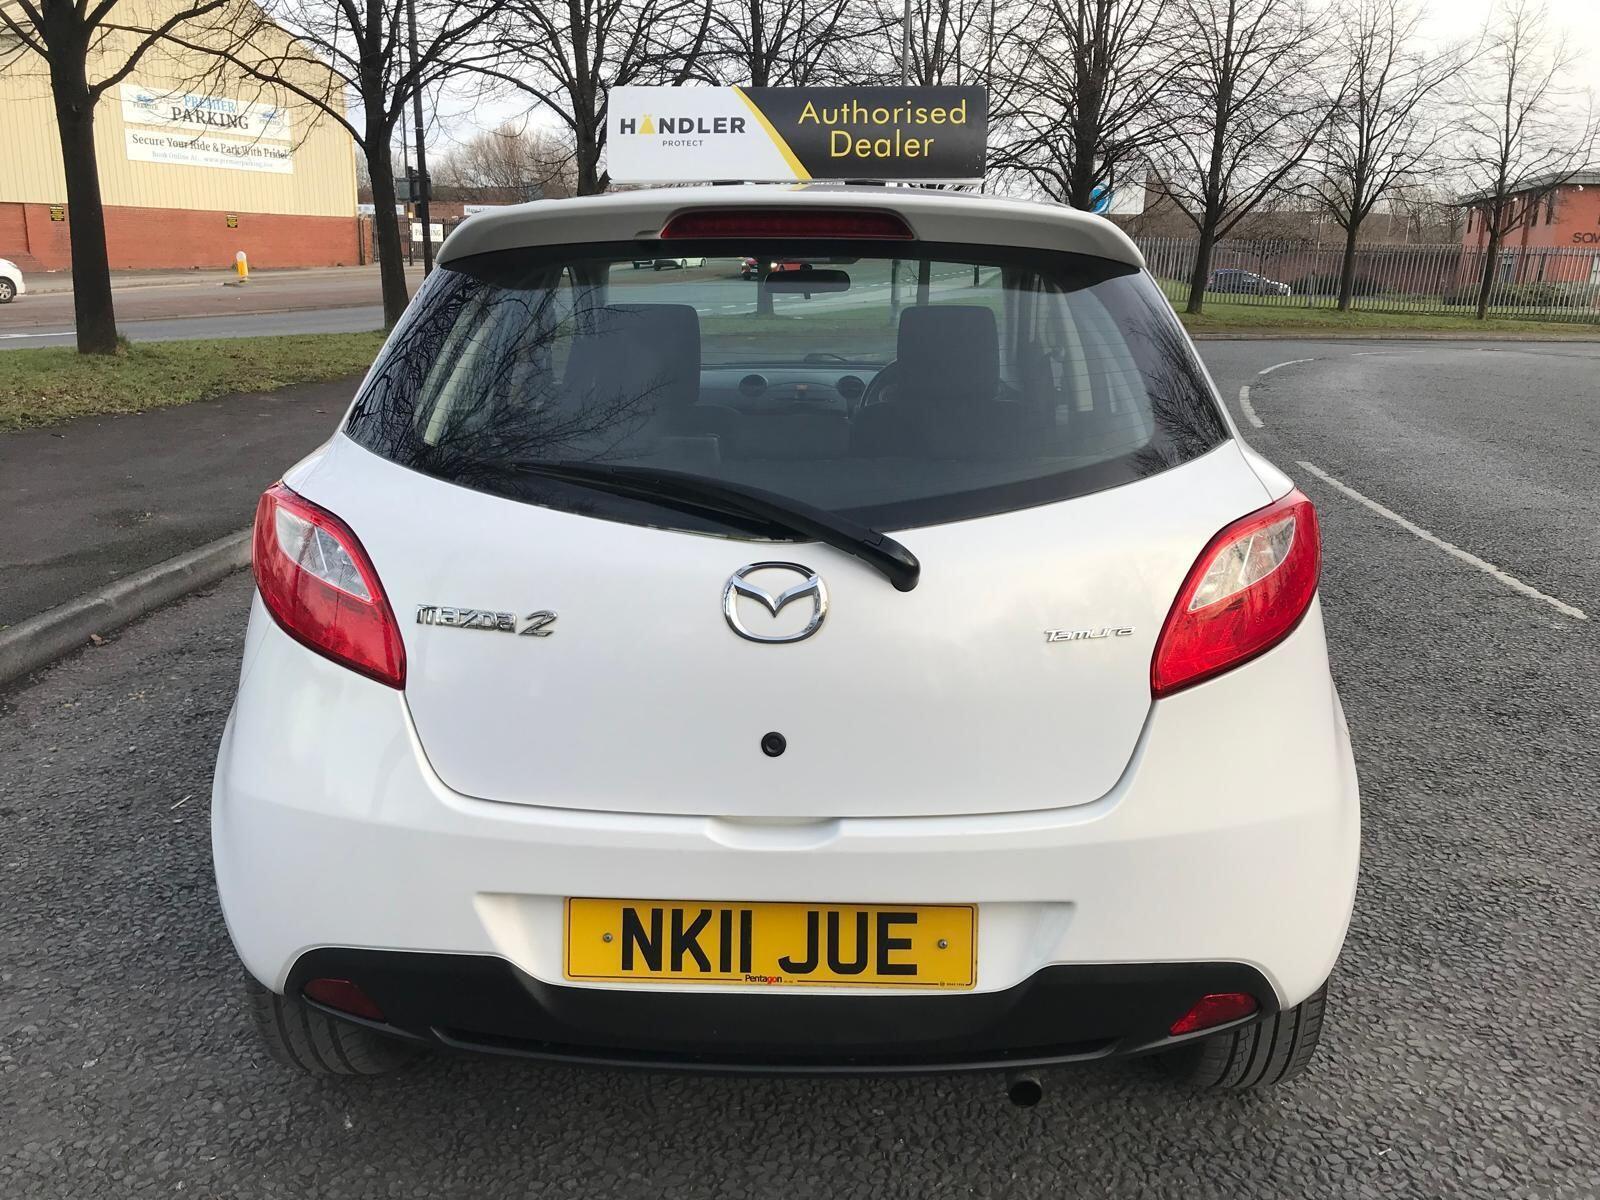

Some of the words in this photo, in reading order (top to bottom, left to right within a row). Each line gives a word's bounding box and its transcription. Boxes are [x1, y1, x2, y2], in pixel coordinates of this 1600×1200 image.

[171, 106, 249, 130] PARKING
[798, 99, 966, 125] Authorised
[132, 133, 165, 147] Secure
[166, 137, 189, 149] Your
[190, 139, 211, 152] Ride
[212, 142, 219, 153] &
[220, 143, 241, 156] Park
[241, 145, 262, 157] With
[662, 139, 704, 147] PROTECT
[830, 129, 935, 158] Dealer
[1044, 626, 1137, 643] Tamura
[621, 907, 753, 973] NK11
[777, 910, 918, 976] JUE
[745, 974, 783, 985] Pentagon
